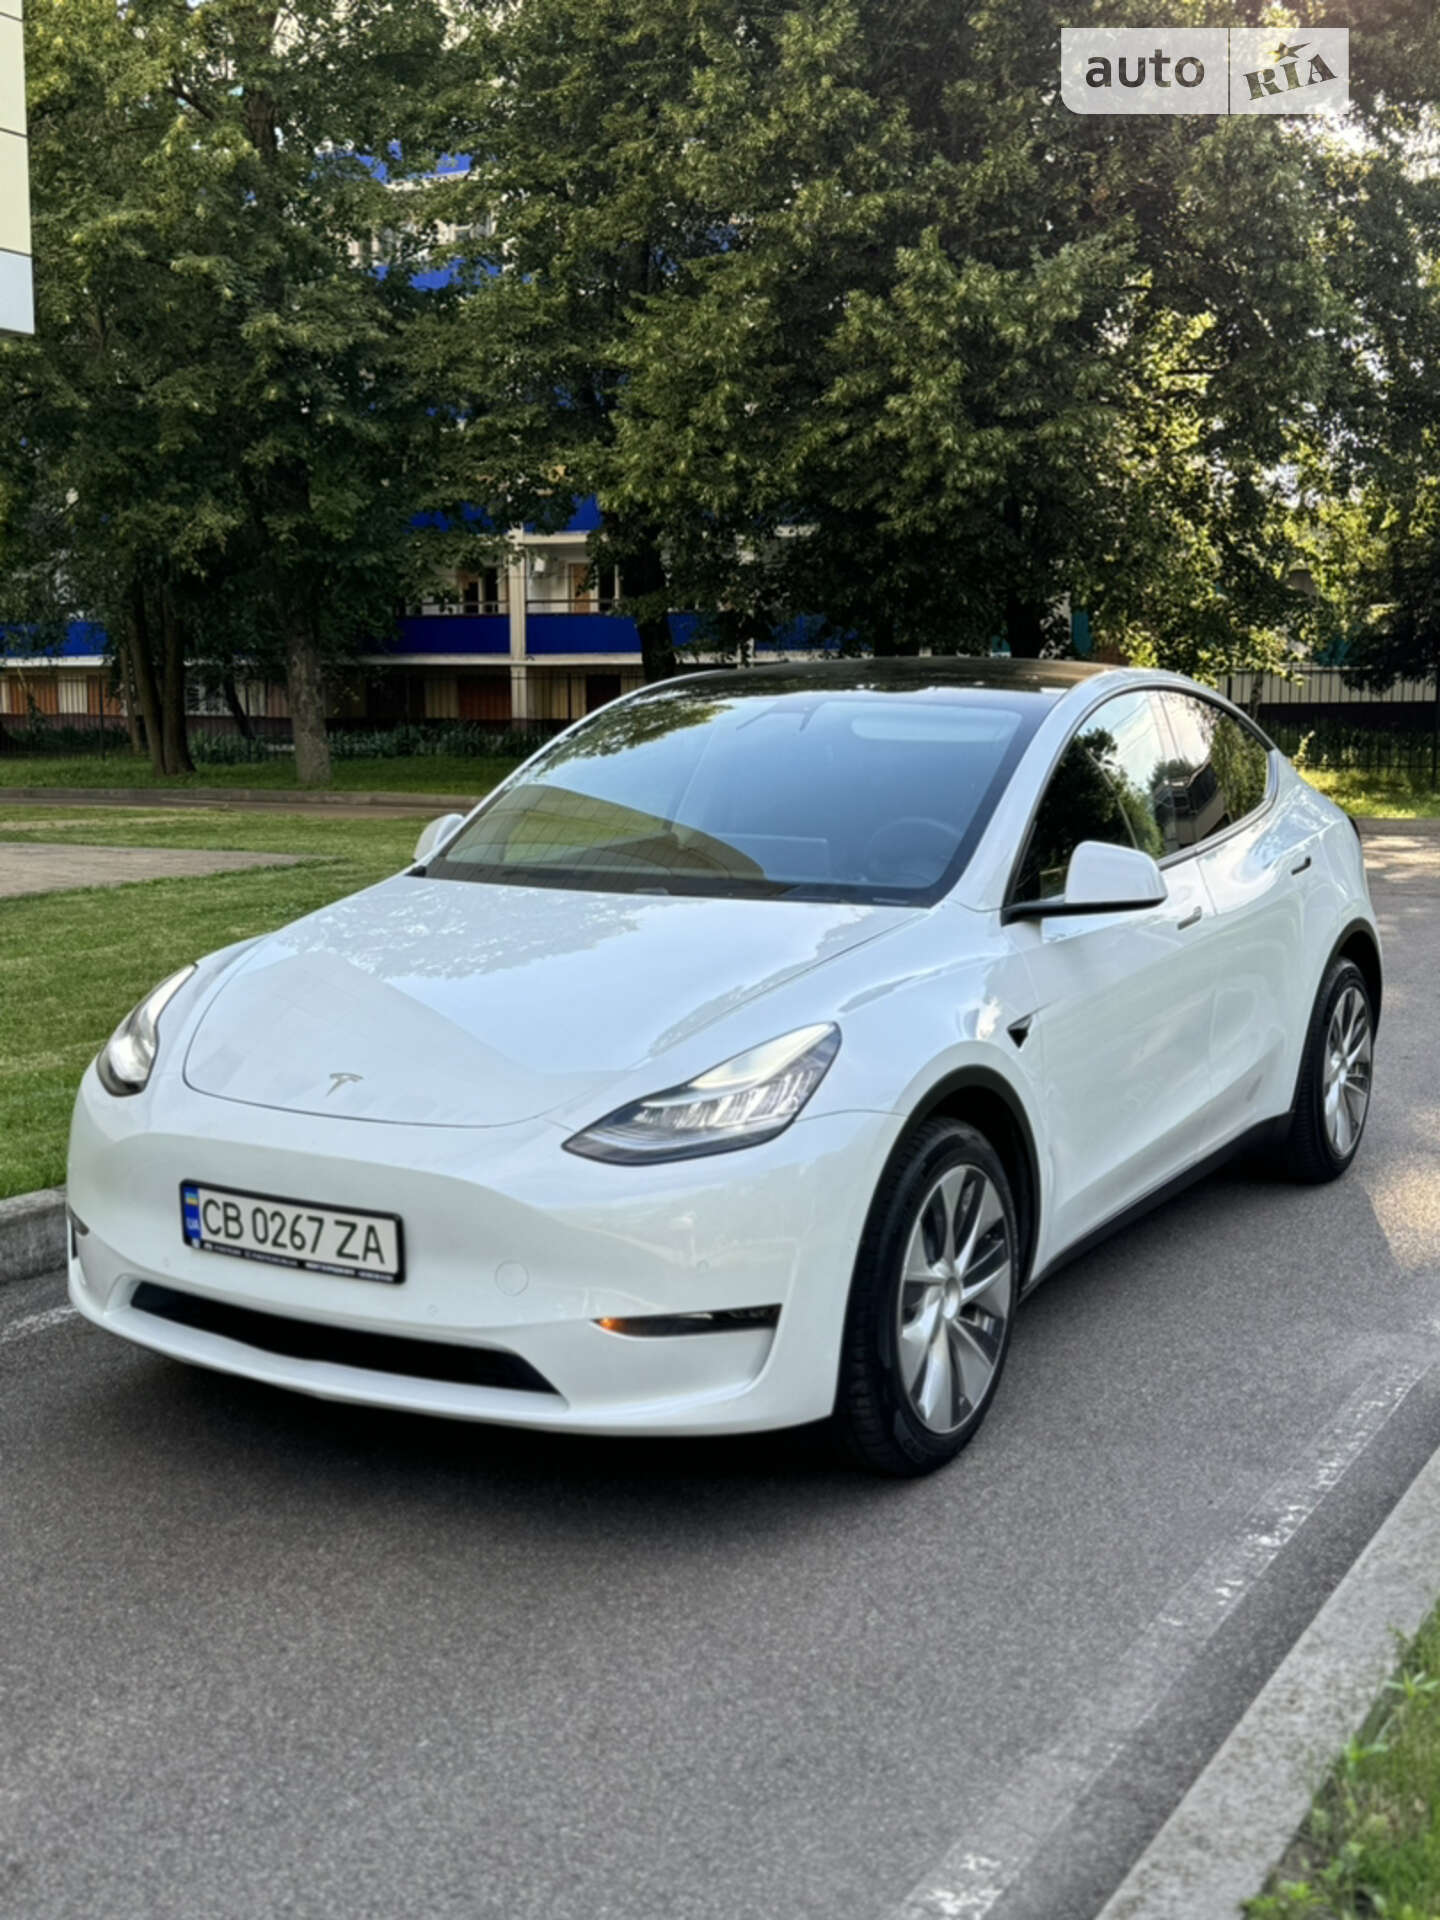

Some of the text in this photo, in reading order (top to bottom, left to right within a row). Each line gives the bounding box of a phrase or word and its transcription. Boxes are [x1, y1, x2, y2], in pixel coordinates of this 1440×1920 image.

[202, 1198, 244, 1240] CB
[251, 1206, 325, 1254] 0267
[334, 1219, 385, 1265] ZA
